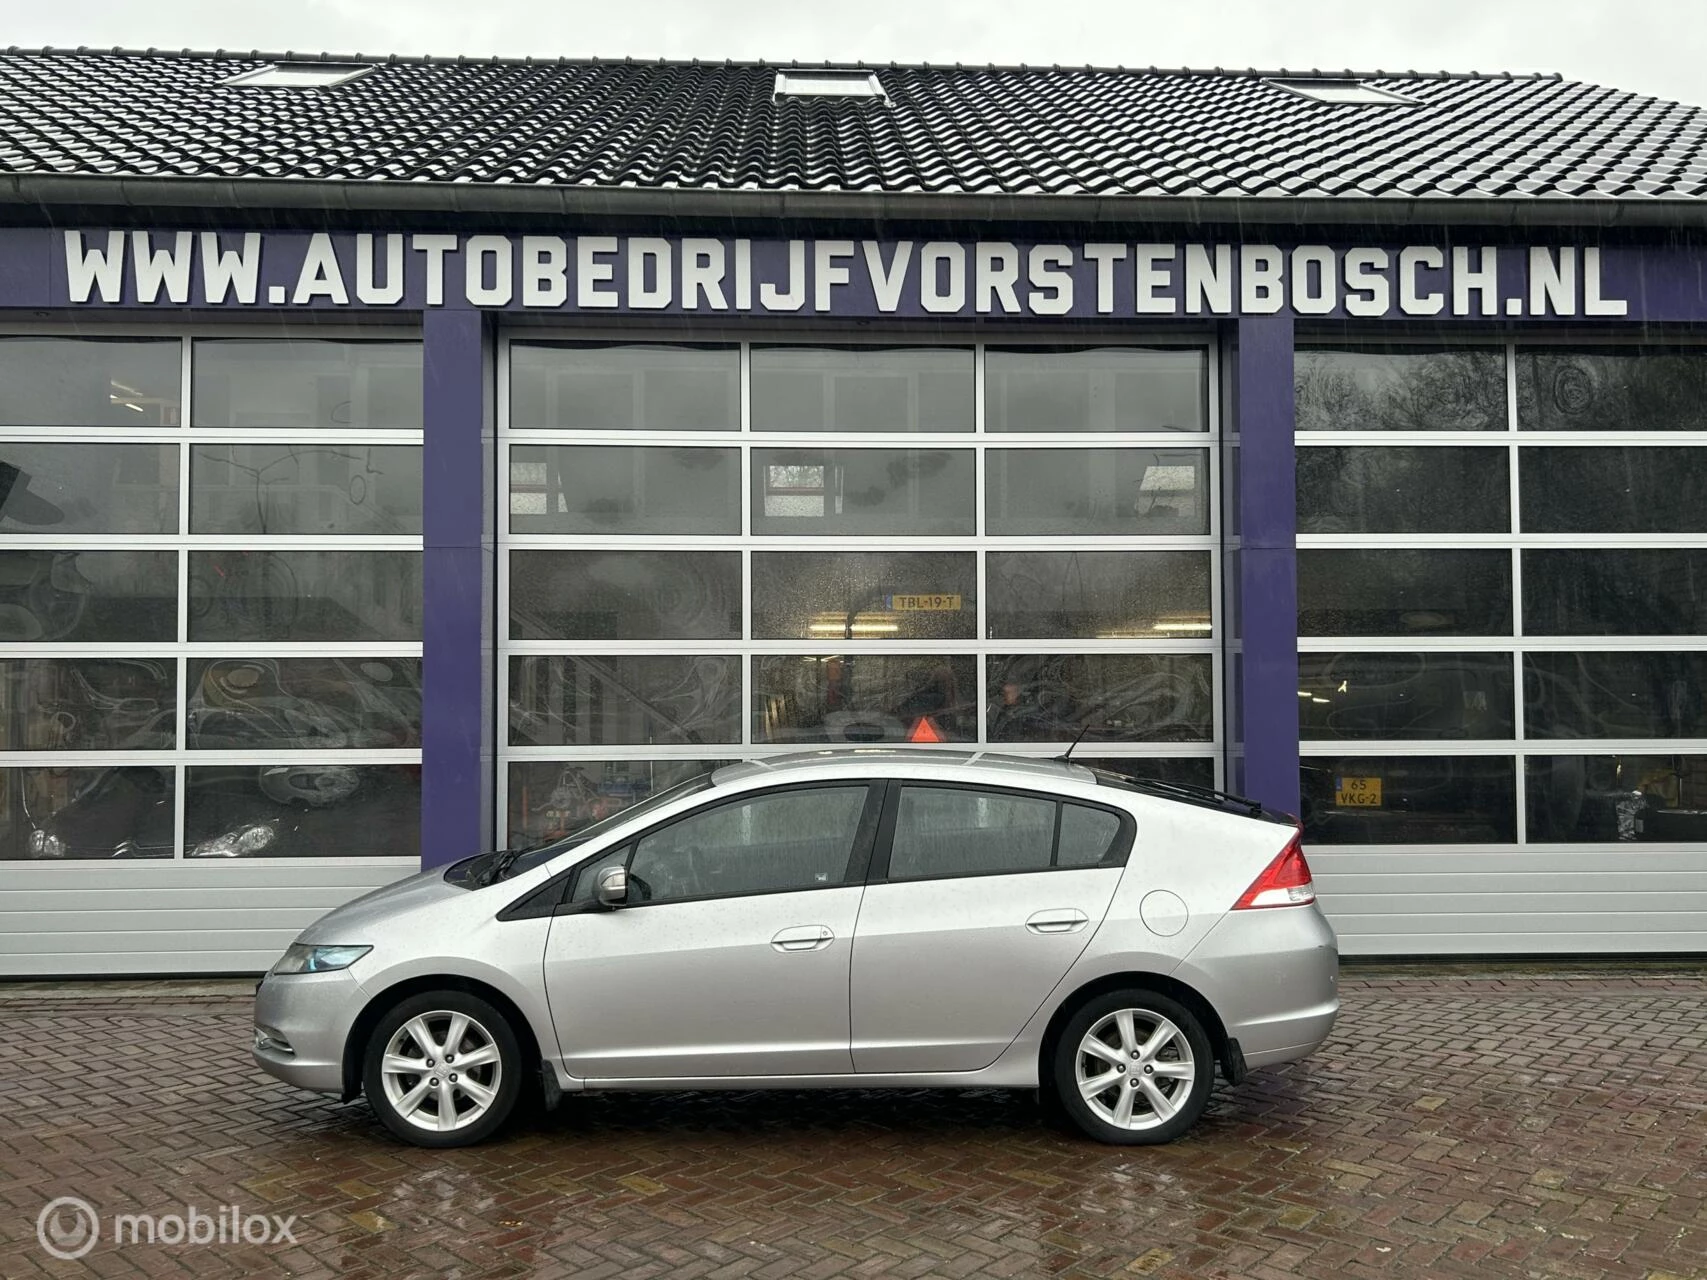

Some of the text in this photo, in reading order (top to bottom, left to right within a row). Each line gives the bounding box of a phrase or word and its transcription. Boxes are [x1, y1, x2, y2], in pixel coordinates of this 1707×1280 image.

[64, 230, 1628, 316] WWW.AUTOBEDRIJFVORSTENBOSCH.NL
[899, 596, 954, 609] TBL-19-T
[1351, 780, 1367, 790] 65
[1341, 793, 1377, 804] VKG-2
